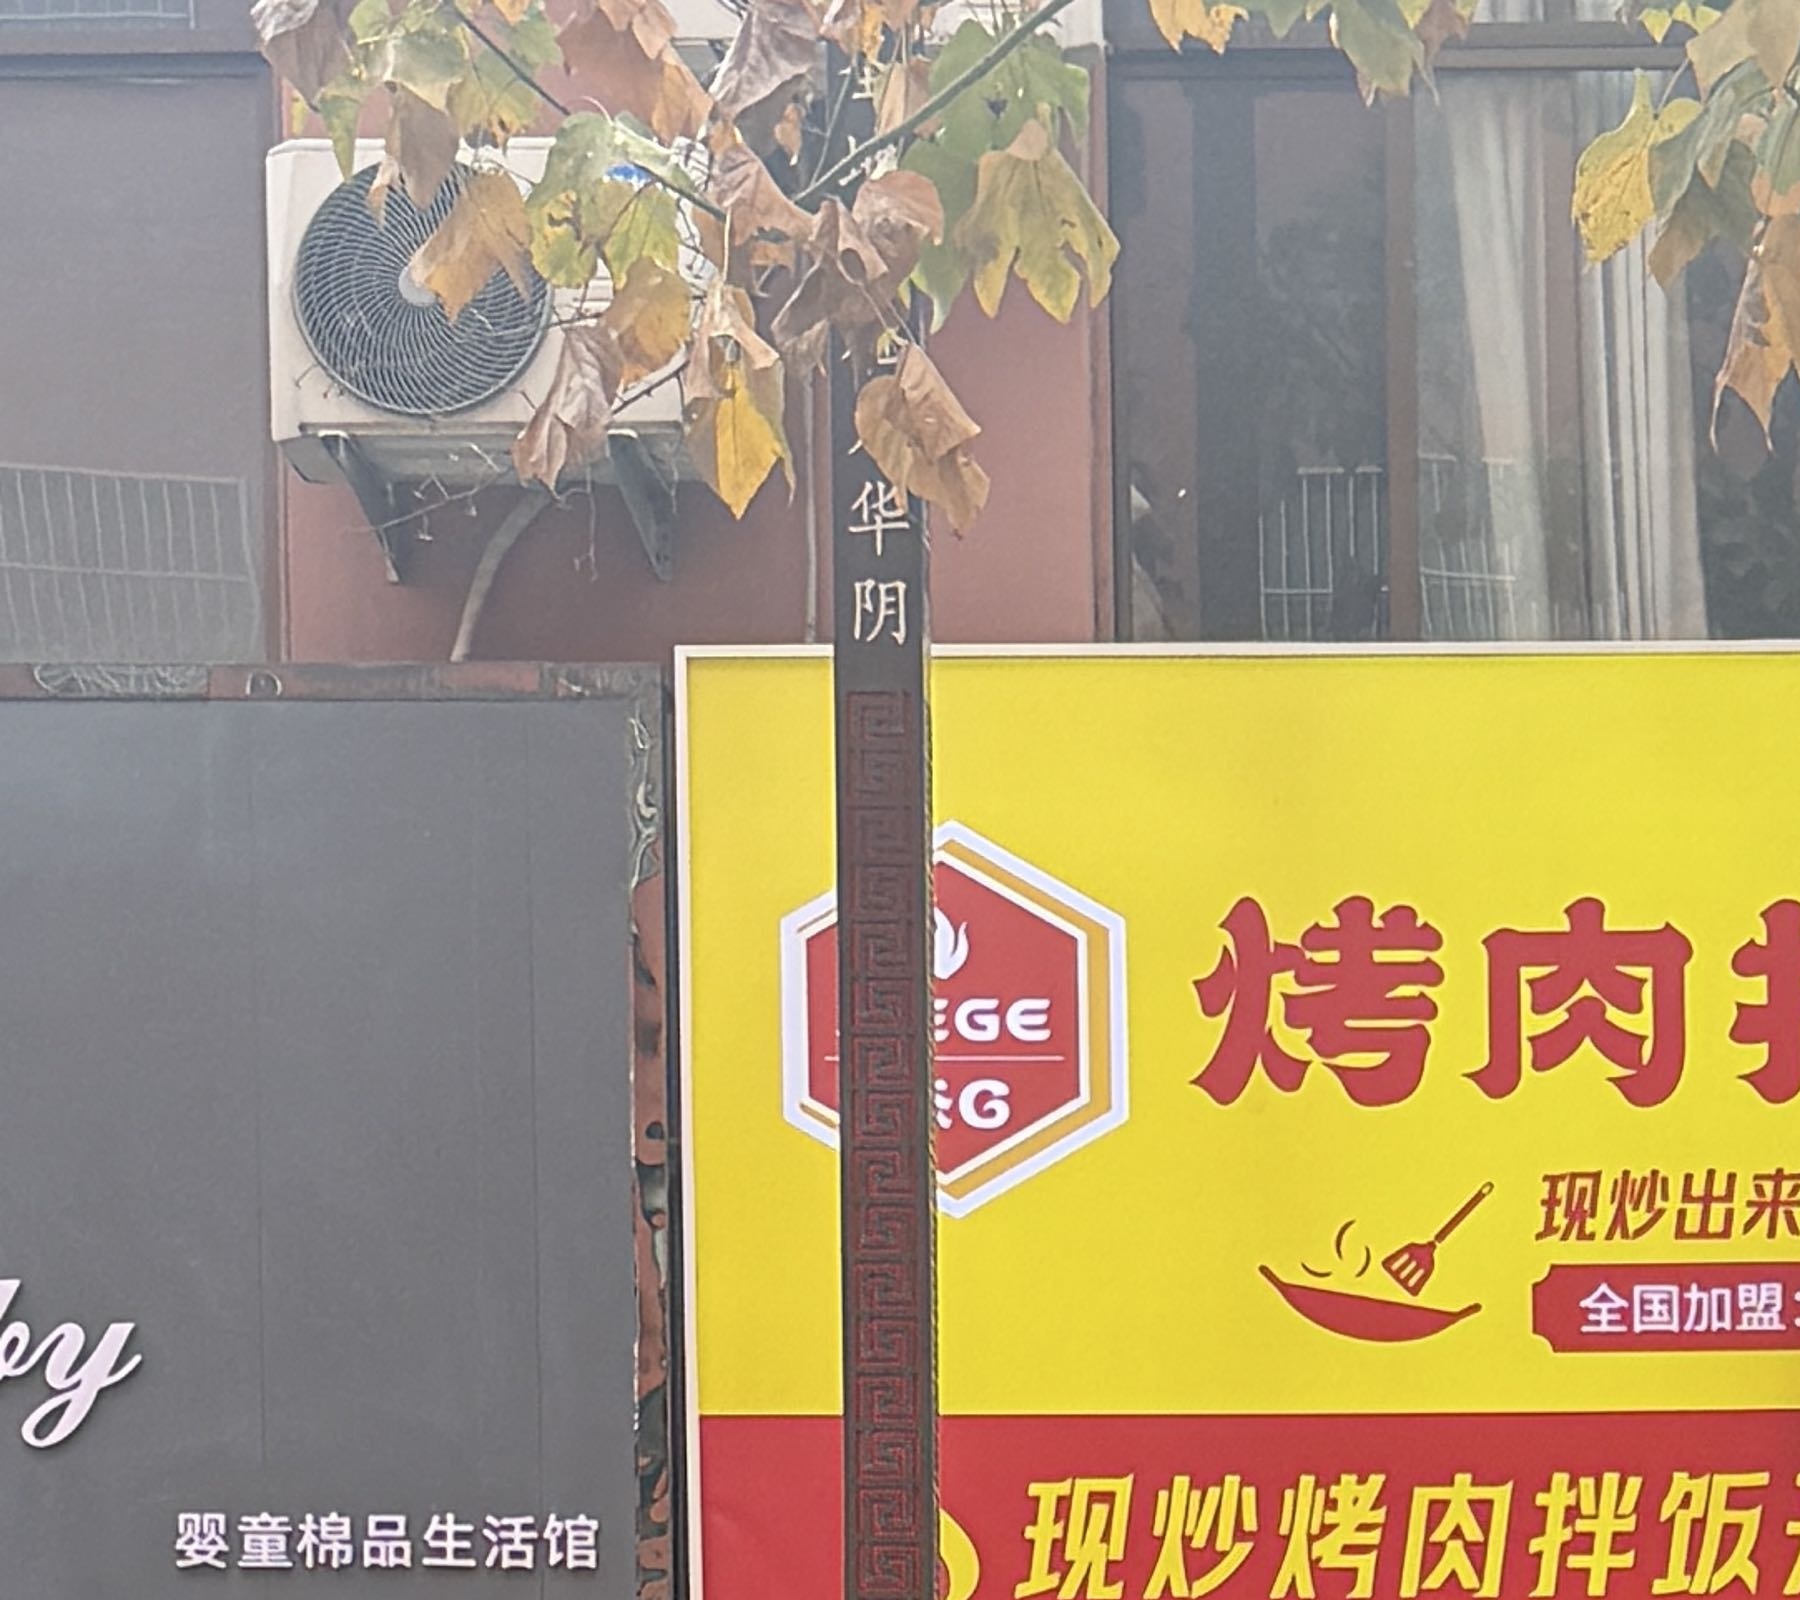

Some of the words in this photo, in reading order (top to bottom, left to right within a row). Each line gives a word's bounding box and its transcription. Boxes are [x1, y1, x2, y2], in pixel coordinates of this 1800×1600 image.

[174, 1512, 599, 1571] 婴童棉品生活馆
